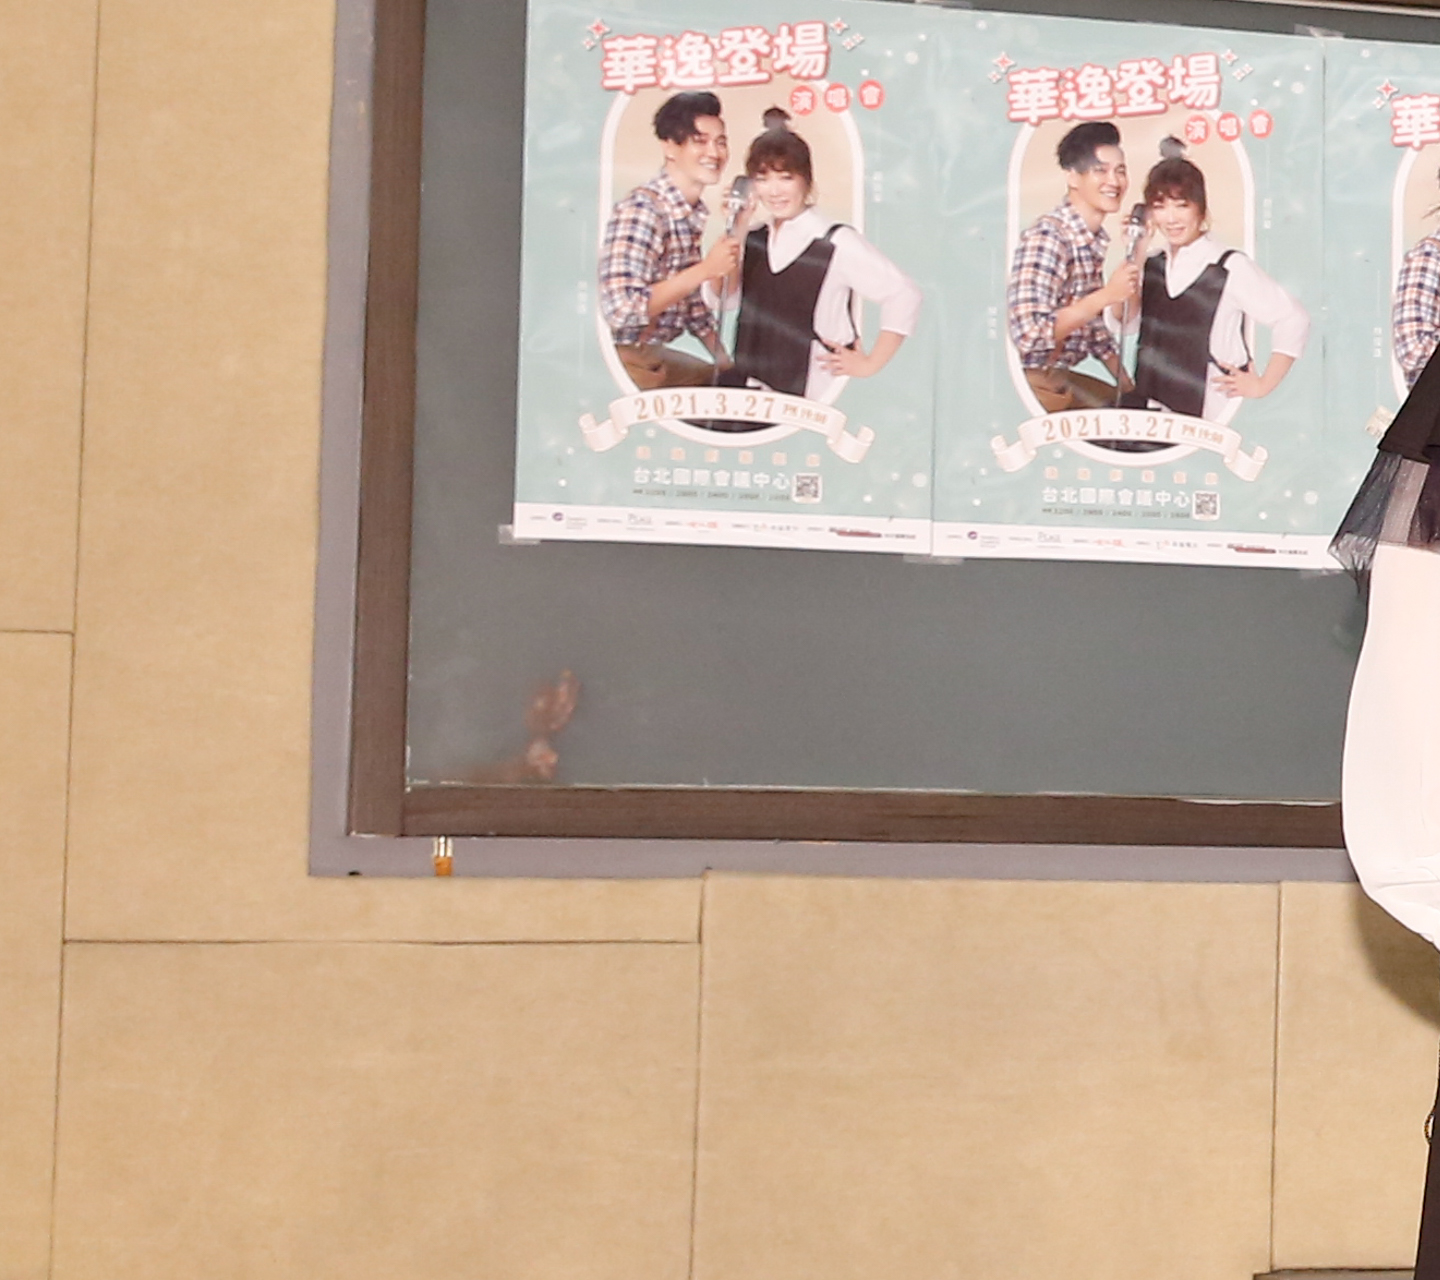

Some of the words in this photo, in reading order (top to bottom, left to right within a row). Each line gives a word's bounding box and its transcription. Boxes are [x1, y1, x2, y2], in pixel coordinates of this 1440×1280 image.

[601, 20, 830, 94] 華逸登場
[789, 79, 885, 115] 演唱會
[1007, 52, 1222, 126] 華逸登場
[1185, 109, 1273, 144] 演唱會
[634, 393, 775, 420] 2021.3.27
[1042, 414, 1175, 441] 2021.3.27
